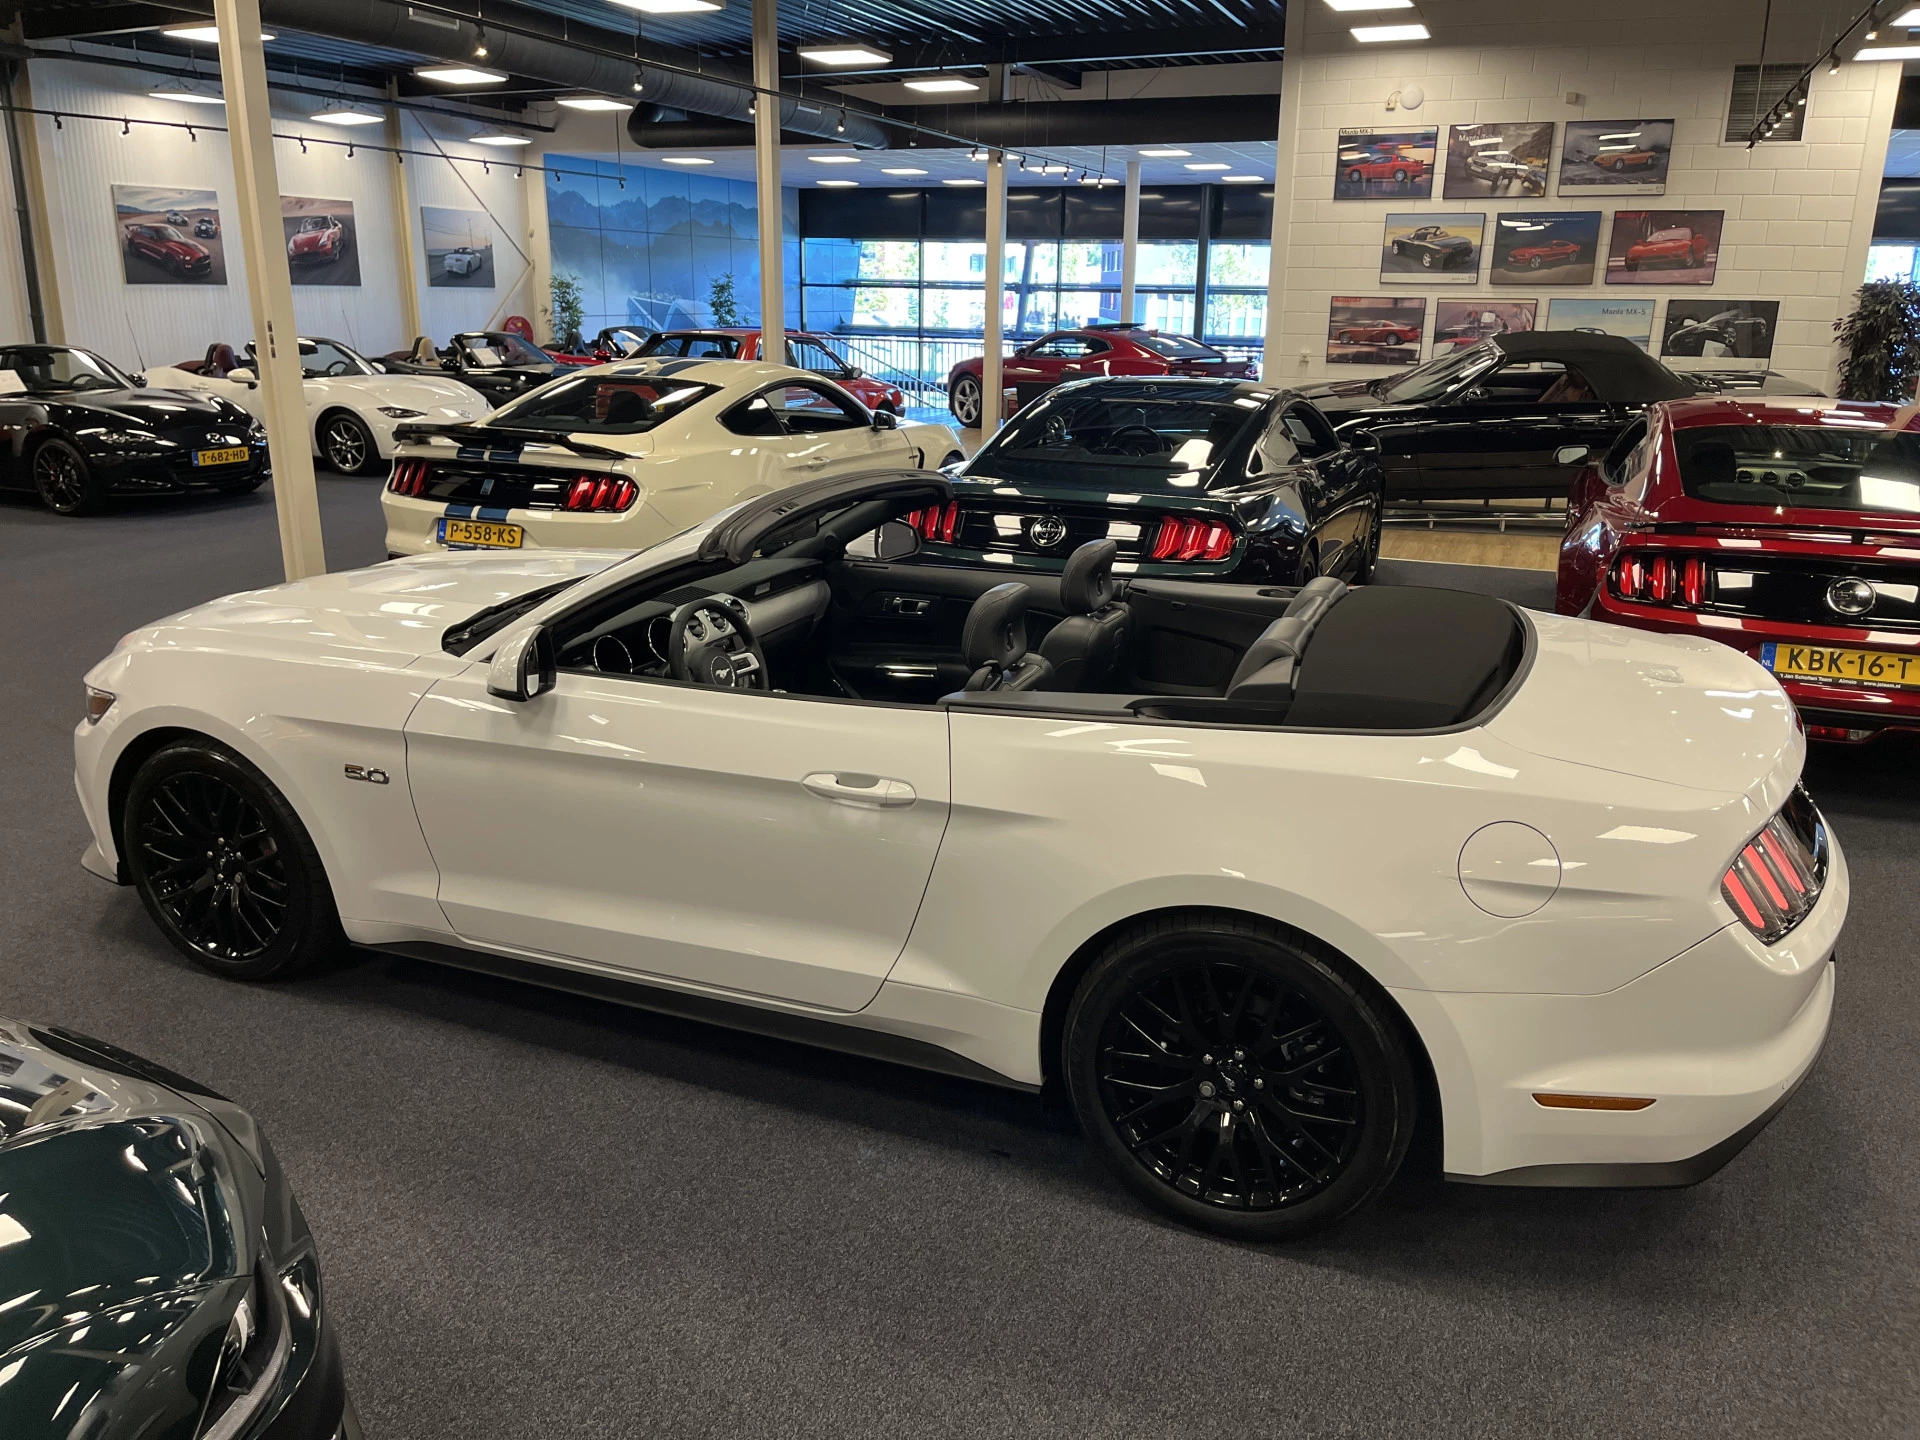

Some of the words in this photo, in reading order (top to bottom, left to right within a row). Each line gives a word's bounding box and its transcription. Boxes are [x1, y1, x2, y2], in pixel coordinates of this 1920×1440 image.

[1601, 307, 1624, 315] Mazda
[1625, 308, 1647, 316] MX-5
[201, 449, 246, 464] T-682-HD
[450, 523, 516, 544] P-558-KS
[1761, 659, 1773, 668] NL
[1787, 648, 1913, 680] KBK-16-T
[344, 763, 390, 785] 5.0
